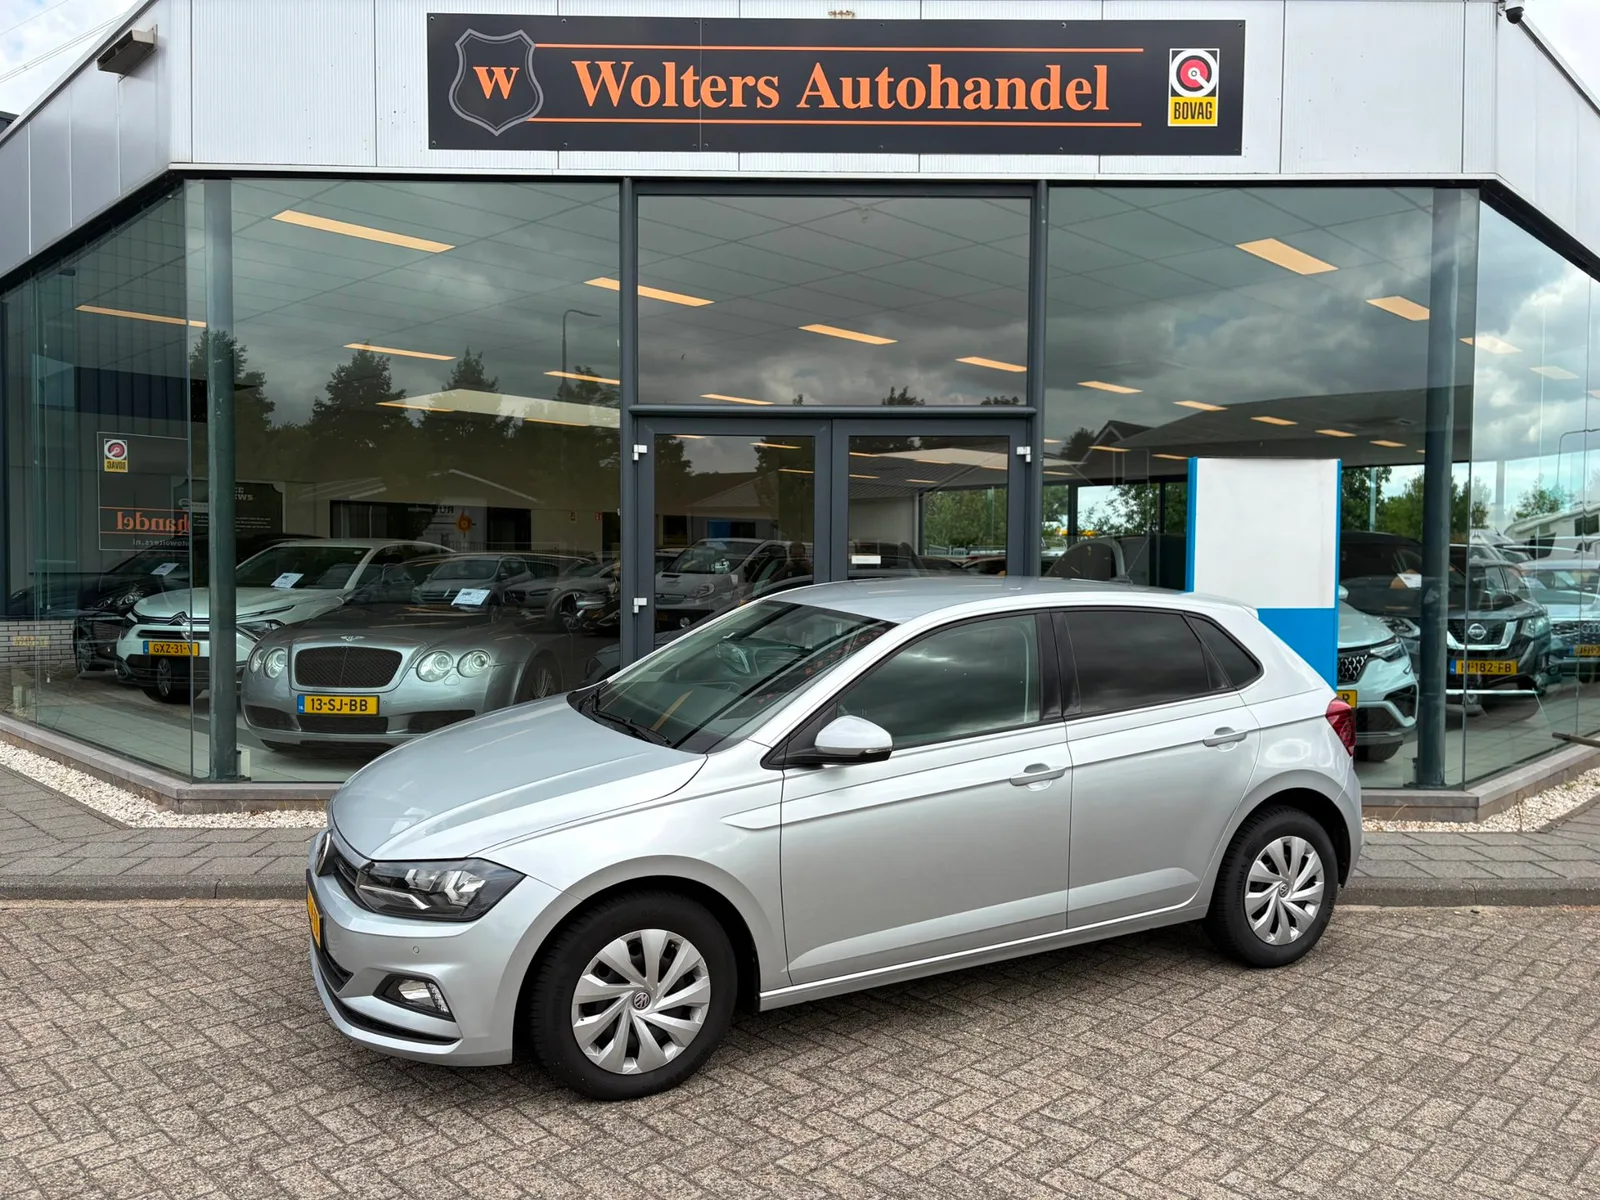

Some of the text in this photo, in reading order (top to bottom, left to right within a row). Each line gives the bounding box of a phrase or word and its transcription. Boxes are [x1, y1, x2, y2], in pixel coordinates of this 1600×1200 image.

[473, 66, 520, 100] W
[572, 60, 1110, 111] Wolters Autohandel
[1173, 100, 1213, 121] BOVAG
[311, 698, 369, 712] 13-SJ-BB
